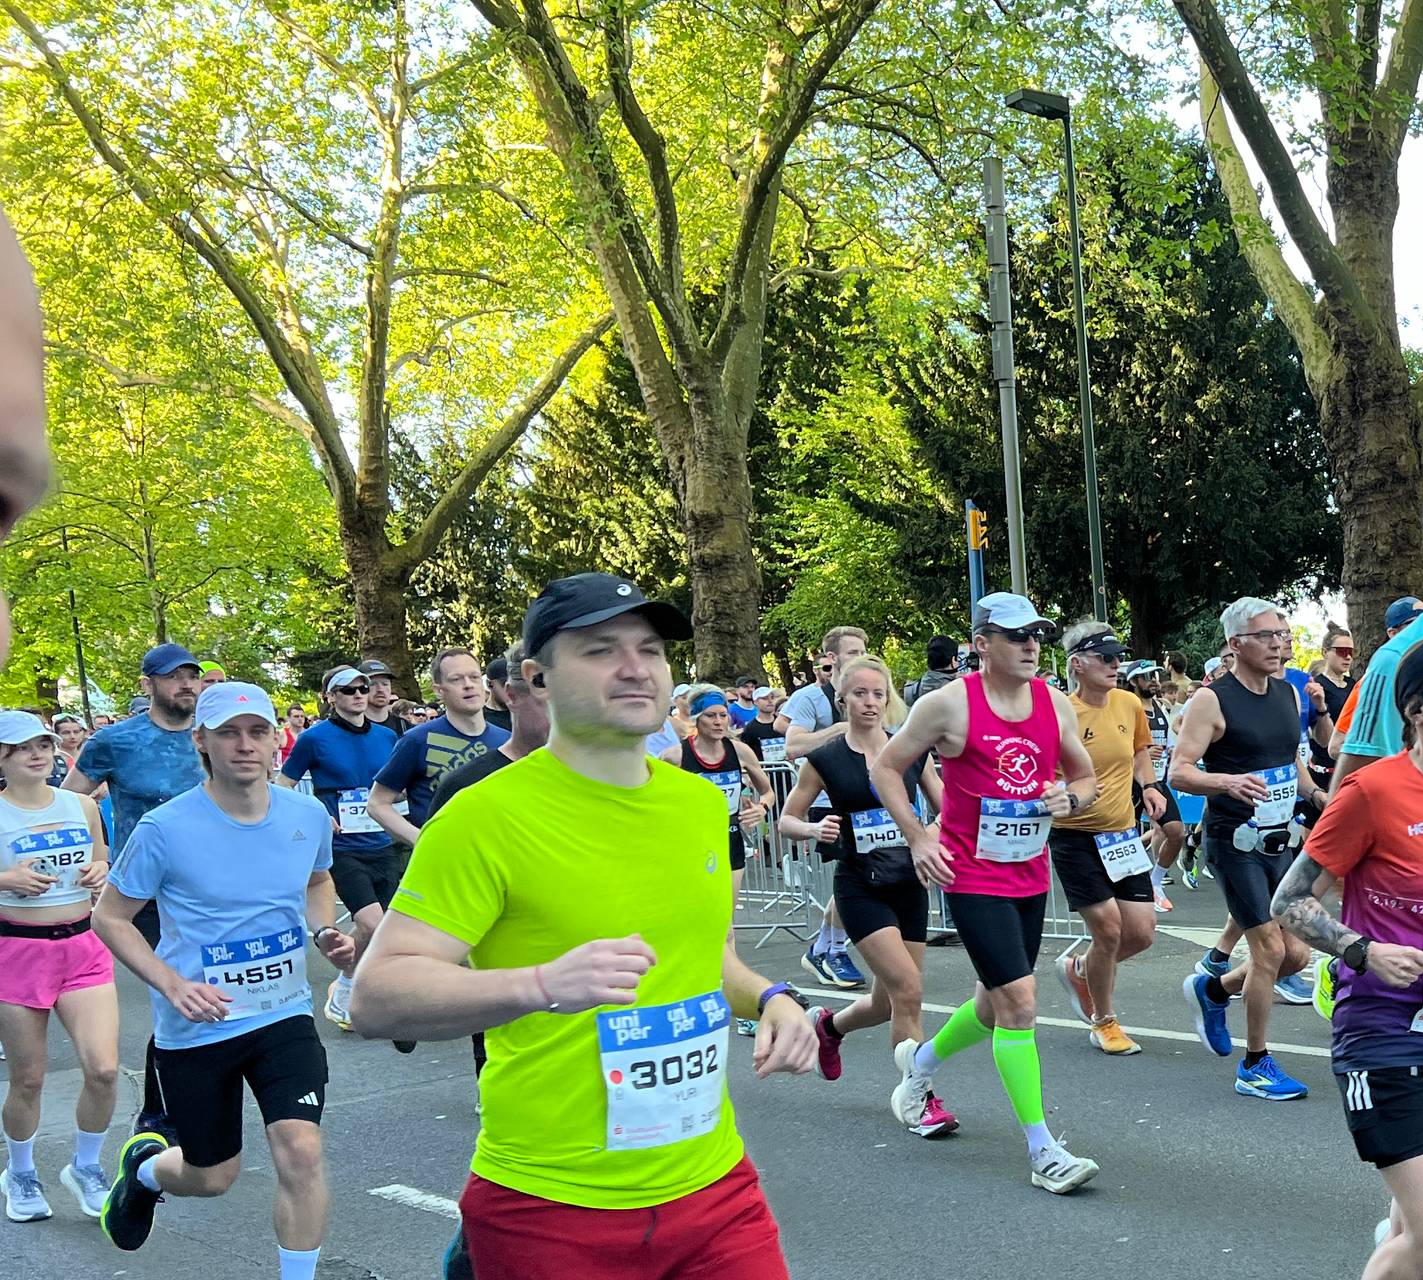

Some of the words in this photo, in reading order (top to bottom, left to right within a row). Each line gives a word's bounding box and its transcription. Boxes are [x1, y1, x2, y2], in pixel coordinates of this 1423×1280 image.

[995, 822, 1040, 837] 2161
[245, 938, 263, 950] uni
[278, 929, 293, 943] uni
[282, 936, 299, 951] per
[207, 944, 228, 956] uni
[212, 950, 235, 963] per
[250, 944, 271, 959] per
[224, 959, 293, 986] 4551
[666, 1002, 688, 1023] uni
[699, 994, 720, 1013] uni
[608, 1009, 641, 1030] uni
[673, 1015, 697, 1038] per
[706, 1007, 727, 1028] per
[616, 1025, 652, 1046] per
[629, 1043, 719, 1091] 3032
